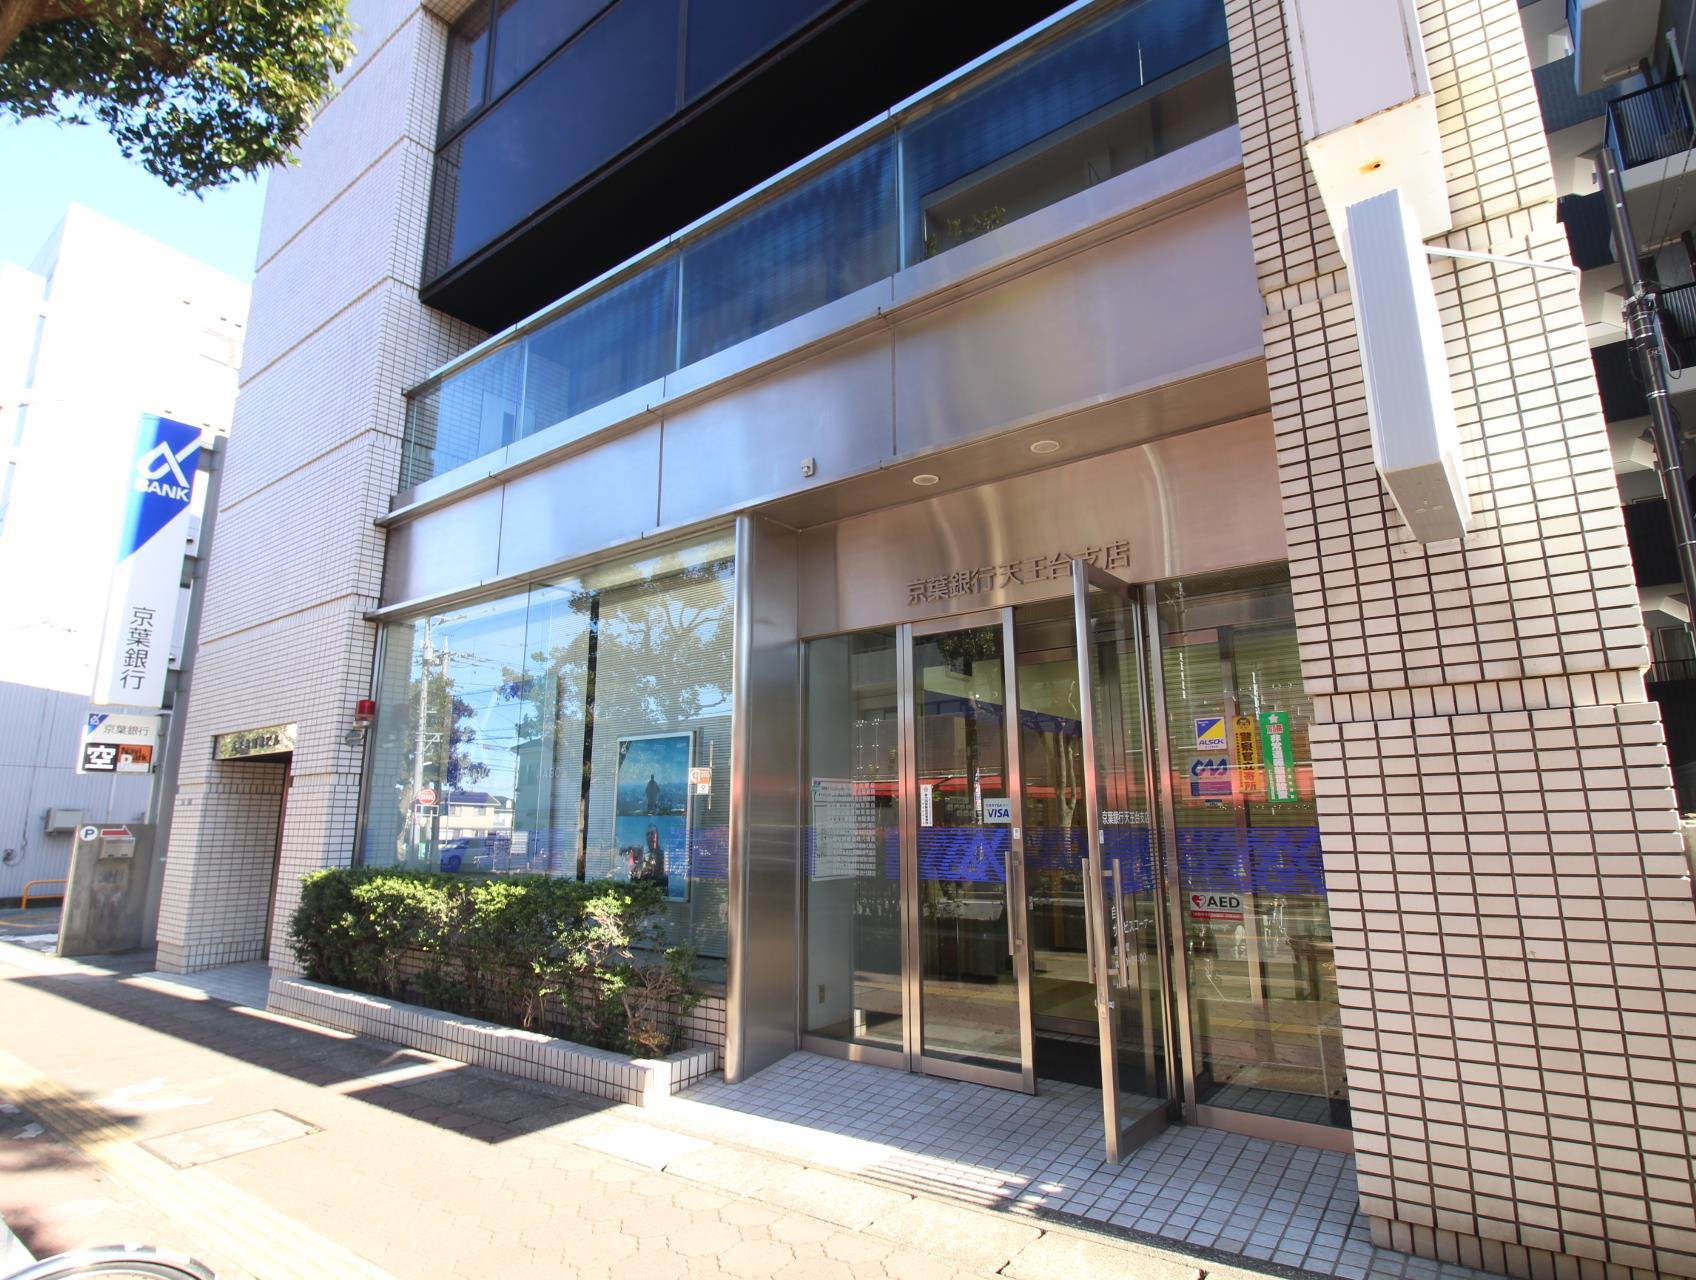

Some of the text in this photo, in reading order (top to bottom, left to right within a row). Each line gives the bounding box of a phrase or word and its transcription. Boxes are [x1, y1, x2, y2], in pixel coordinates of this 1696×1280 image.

[135, 478, 190, 502] BANK
[906, 540, 1131, 607] 京葉銀行天王台支店
[120, 606, 154, 690] 京葉銀行
[103, 724, 150, 736] 京葉銀行
[85, 745, 117, 769] 空
[1240, 732, 1257, 791] 警察官立寄所
[988, 808, 1010, 818] VISA
[84, 829, 96, 840] P
[1207, 896, 1240, 908] AED
[1112, 918, 1154, 937] サビスコーナー
